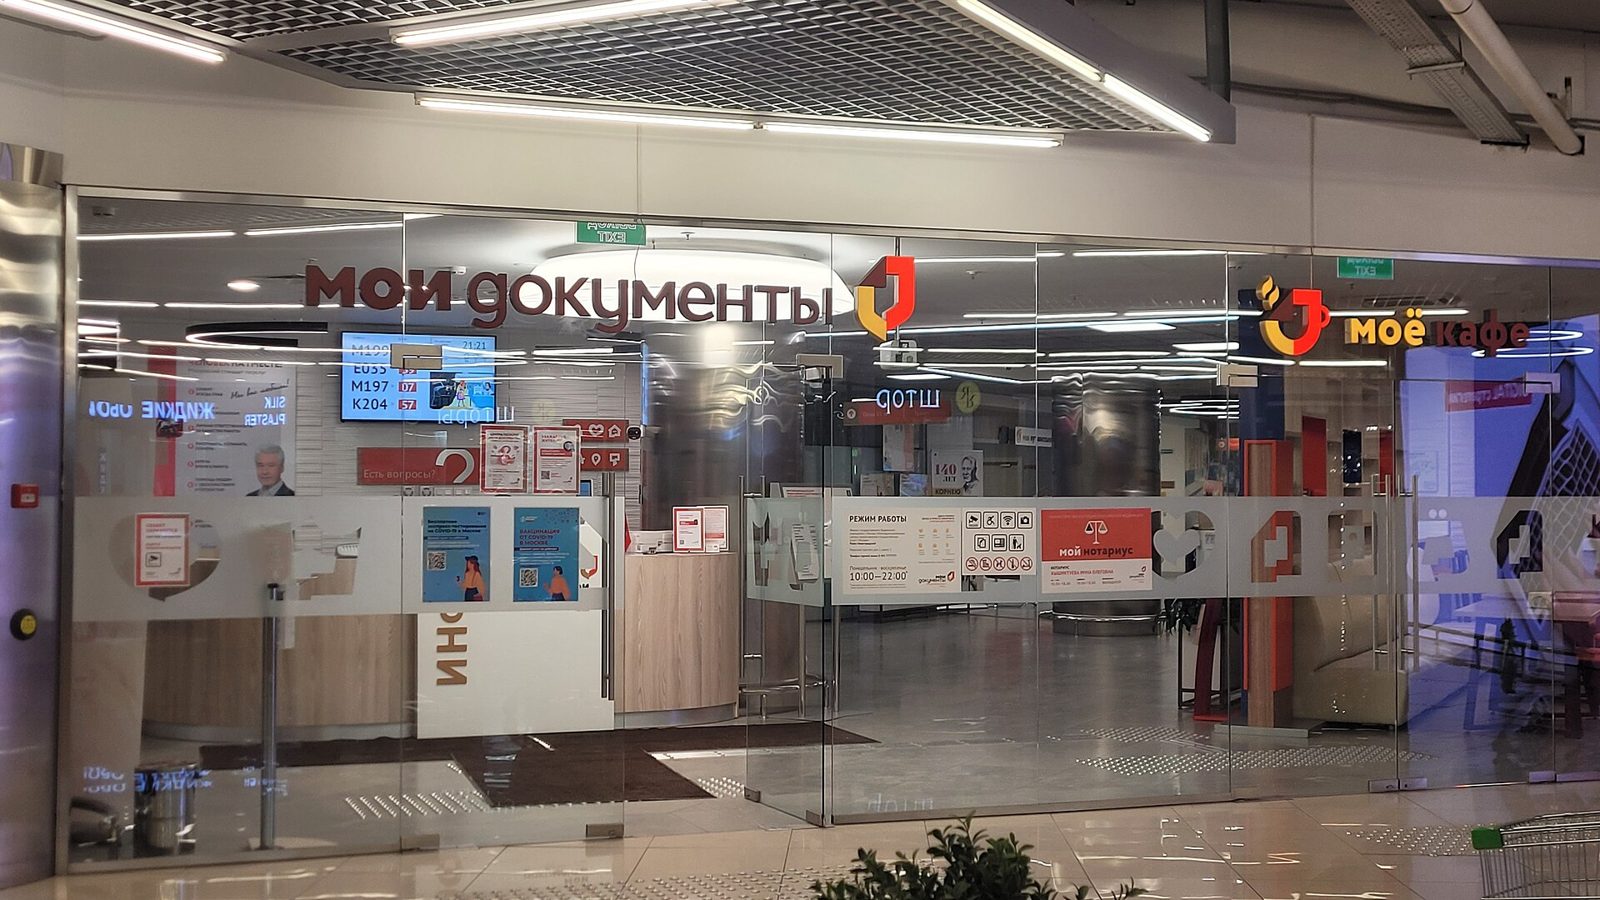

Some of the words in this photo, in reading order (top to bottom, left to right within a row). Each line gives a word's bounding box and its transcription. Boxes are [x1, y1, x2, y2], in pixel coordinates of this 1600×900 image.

[467, 271, 833, 334] документы
[1346, 307, 1427, 346] моё
[1434, 309, 1531, 357] кафе
[402, 382, 414, 391] 07
[353, 398, 388, 410] К204
[402, 400, 414, 410] 57
[363, 469, 385, 479] Есть
[935, 463, 957, 475] 140
[849, 515, 876, 523] РЕЖИМ
[877, 515, 907, 523] РАБОТЫ
[1059, 545, 1082, 557] мой
[1083, 547, 1134, 558] нотариус
